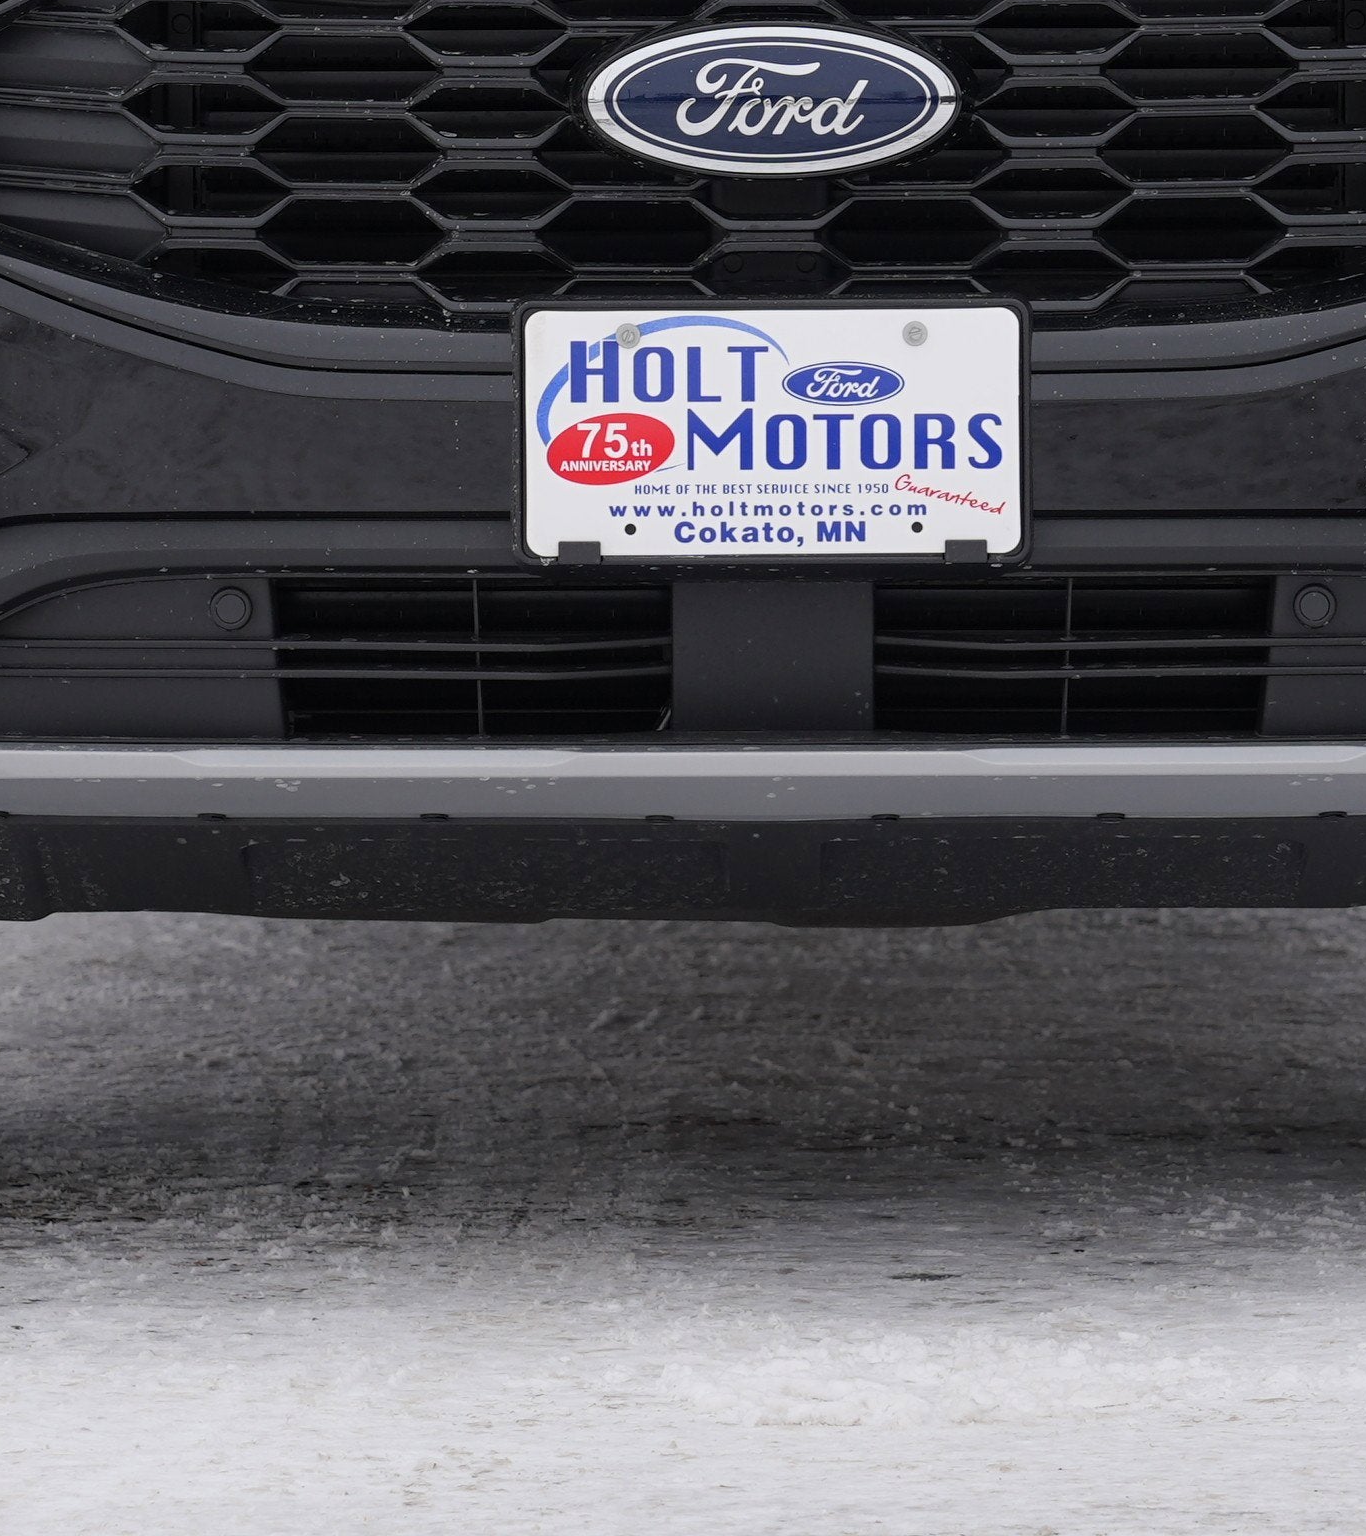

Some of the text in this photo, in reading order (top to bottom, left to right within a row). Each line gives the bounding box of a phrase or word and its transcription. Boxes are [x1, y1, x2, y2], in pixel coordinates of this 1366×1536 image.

[676, 57, 870, 136] Ford
[569, 340, 769, 403] HOLT
[805, 367, 880, 399] Ford
[576, 422, 653, 459] 75th
[687, 407, 1003, 471] MOTORS
[560, 460, 652, 473] ANNIVERSARY
[634, 484, 889, 494] HOME OF THE BEST SERVICE SINCE 1950
[894, 474, 1007, 516] Guaranteed
[609, 501, 927, 517] www.holtmotors.com
[673, 521, 866, 547] Cokato, MN
